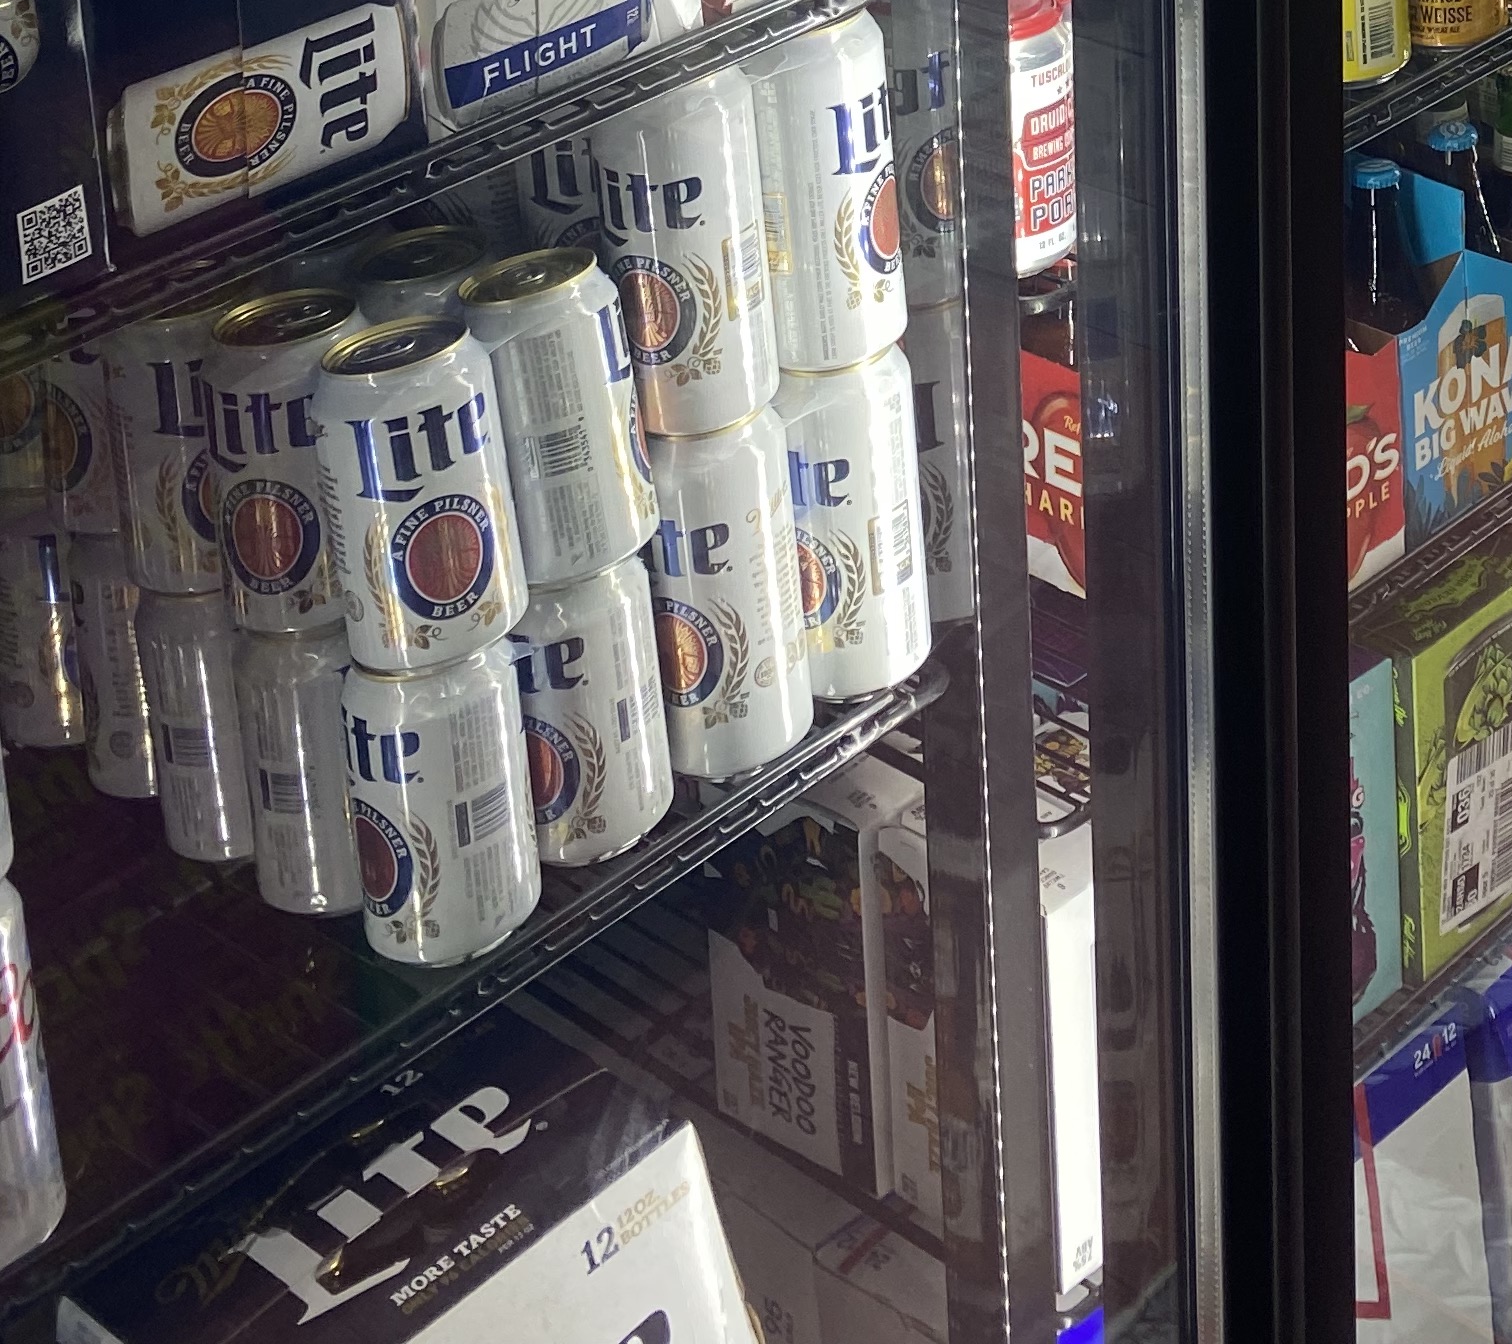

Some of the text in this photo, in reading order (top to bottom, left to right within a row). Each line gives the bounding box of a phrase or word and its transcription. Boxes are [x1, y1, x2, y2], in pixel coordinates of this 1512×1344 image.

[1421, 6, 1472, 24] WEISSE
[482, 23, 598, 91] FLIGHT
[178, 122, 195, 166] BEER
[249, 76, 295, 167] FINE PILSNER
[1030, 105, 1065, 136] DRUID
[1033, 137, 1063, 161] BREWING
[1414, 419, 1456, 471] BIG
[398, 498, 491, 549] FINE PILSNER
[431, 590, 480, 619] BEER
[1413, 1043, 1431, 1071] 24
[1442, 1022, 1457, 1046] 12
[762, 1007, 791, 1126] RANGER
[786, 1023, 817, 1137] VOODOO
[389, 1203, 522, 1307] MORE TASTE
[580, 1226, 620, 1276] 12
